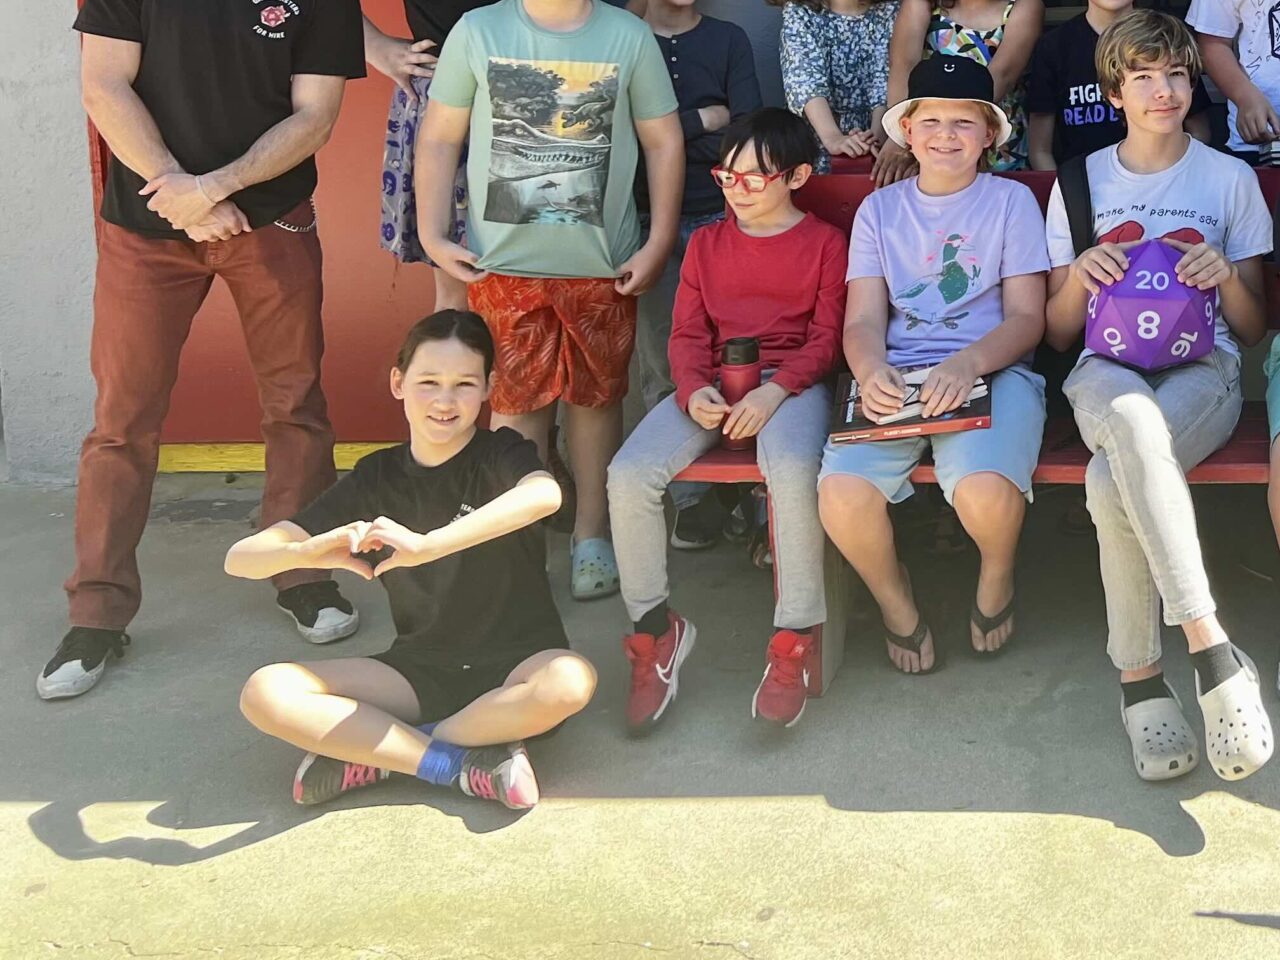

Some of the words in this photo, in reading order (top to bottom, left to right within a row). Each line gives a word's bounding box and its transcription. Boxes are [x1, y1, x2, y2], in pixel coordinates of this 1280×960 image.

[252, 25, 267, 36] FOR
[268, 31, 285, 39] HIRE
[1064, 105, 1105, 126] READ
[1131, 204, 1146, 212] my
[1149, 207, 1197, 218] parents
[1198, 214, 1219, 227] sad
[1135, 270, 1170, 291] 20
[1137, 310, 1161, 340] 8
[1103, 327, 1127, 356] 10
[1170, 331, 1199, 358] 16
